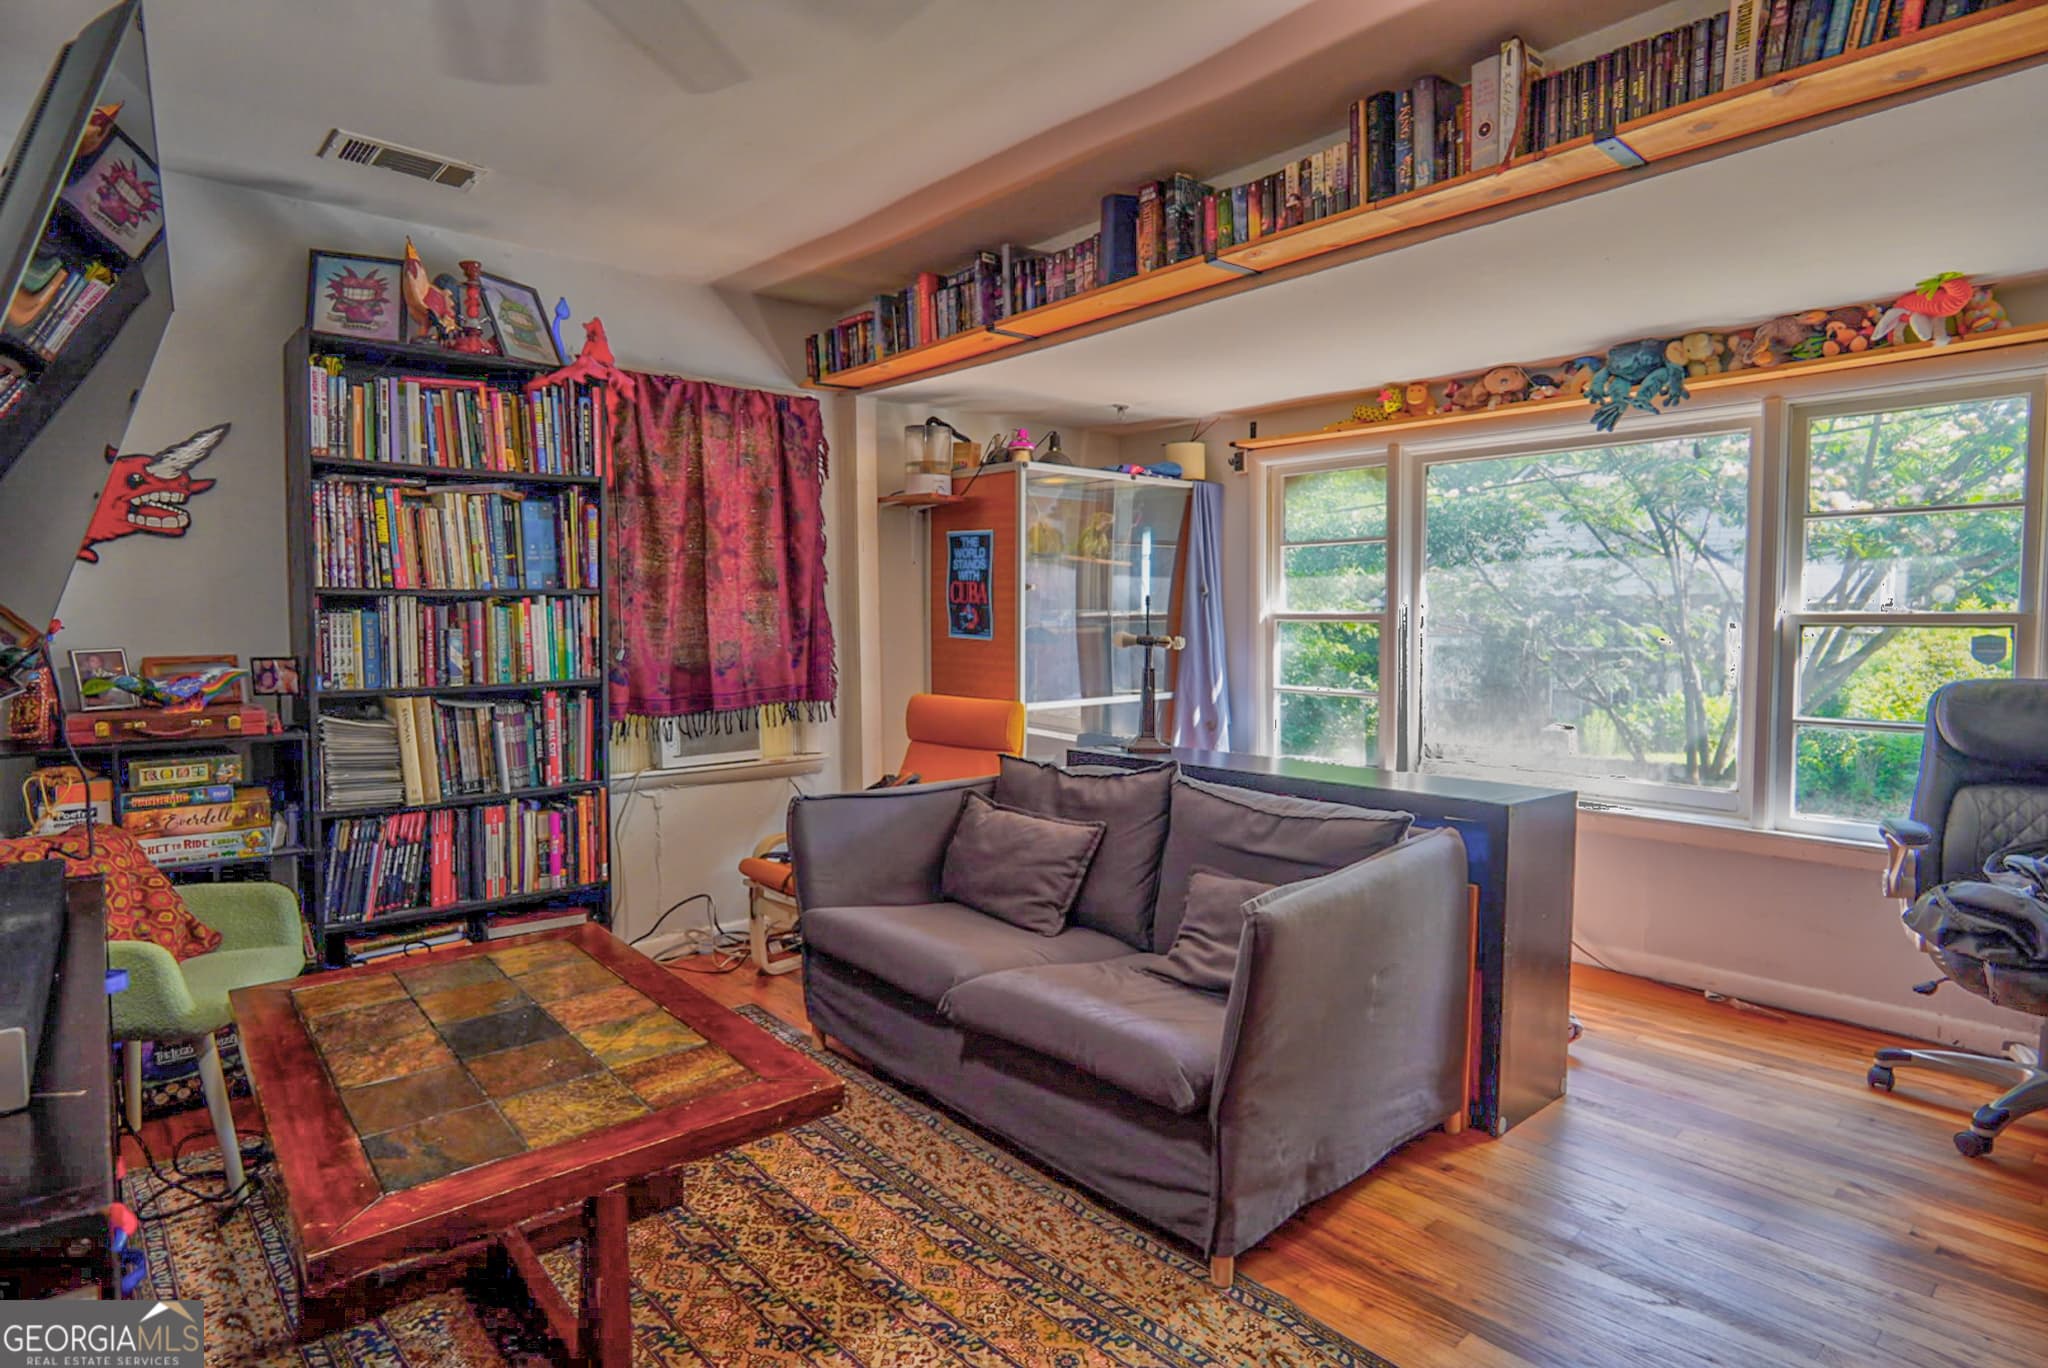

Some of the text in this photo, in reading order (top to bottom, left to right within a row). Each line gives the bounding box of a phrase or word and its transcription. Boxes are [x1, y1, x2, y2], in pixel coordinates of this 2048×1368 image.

[960, 536, 980, 547] THE
[954, 547, 986, 559] WORLD
[953, 558, 987, 570] STANDS
[958, 570, 981, 581] WITH
[949, 582, 988, 605] CUBA
[141, 766, 206, 782] ROOT
[162, 805, 232, 831] Everdell
[183, 839, 210, 850] RIDE
